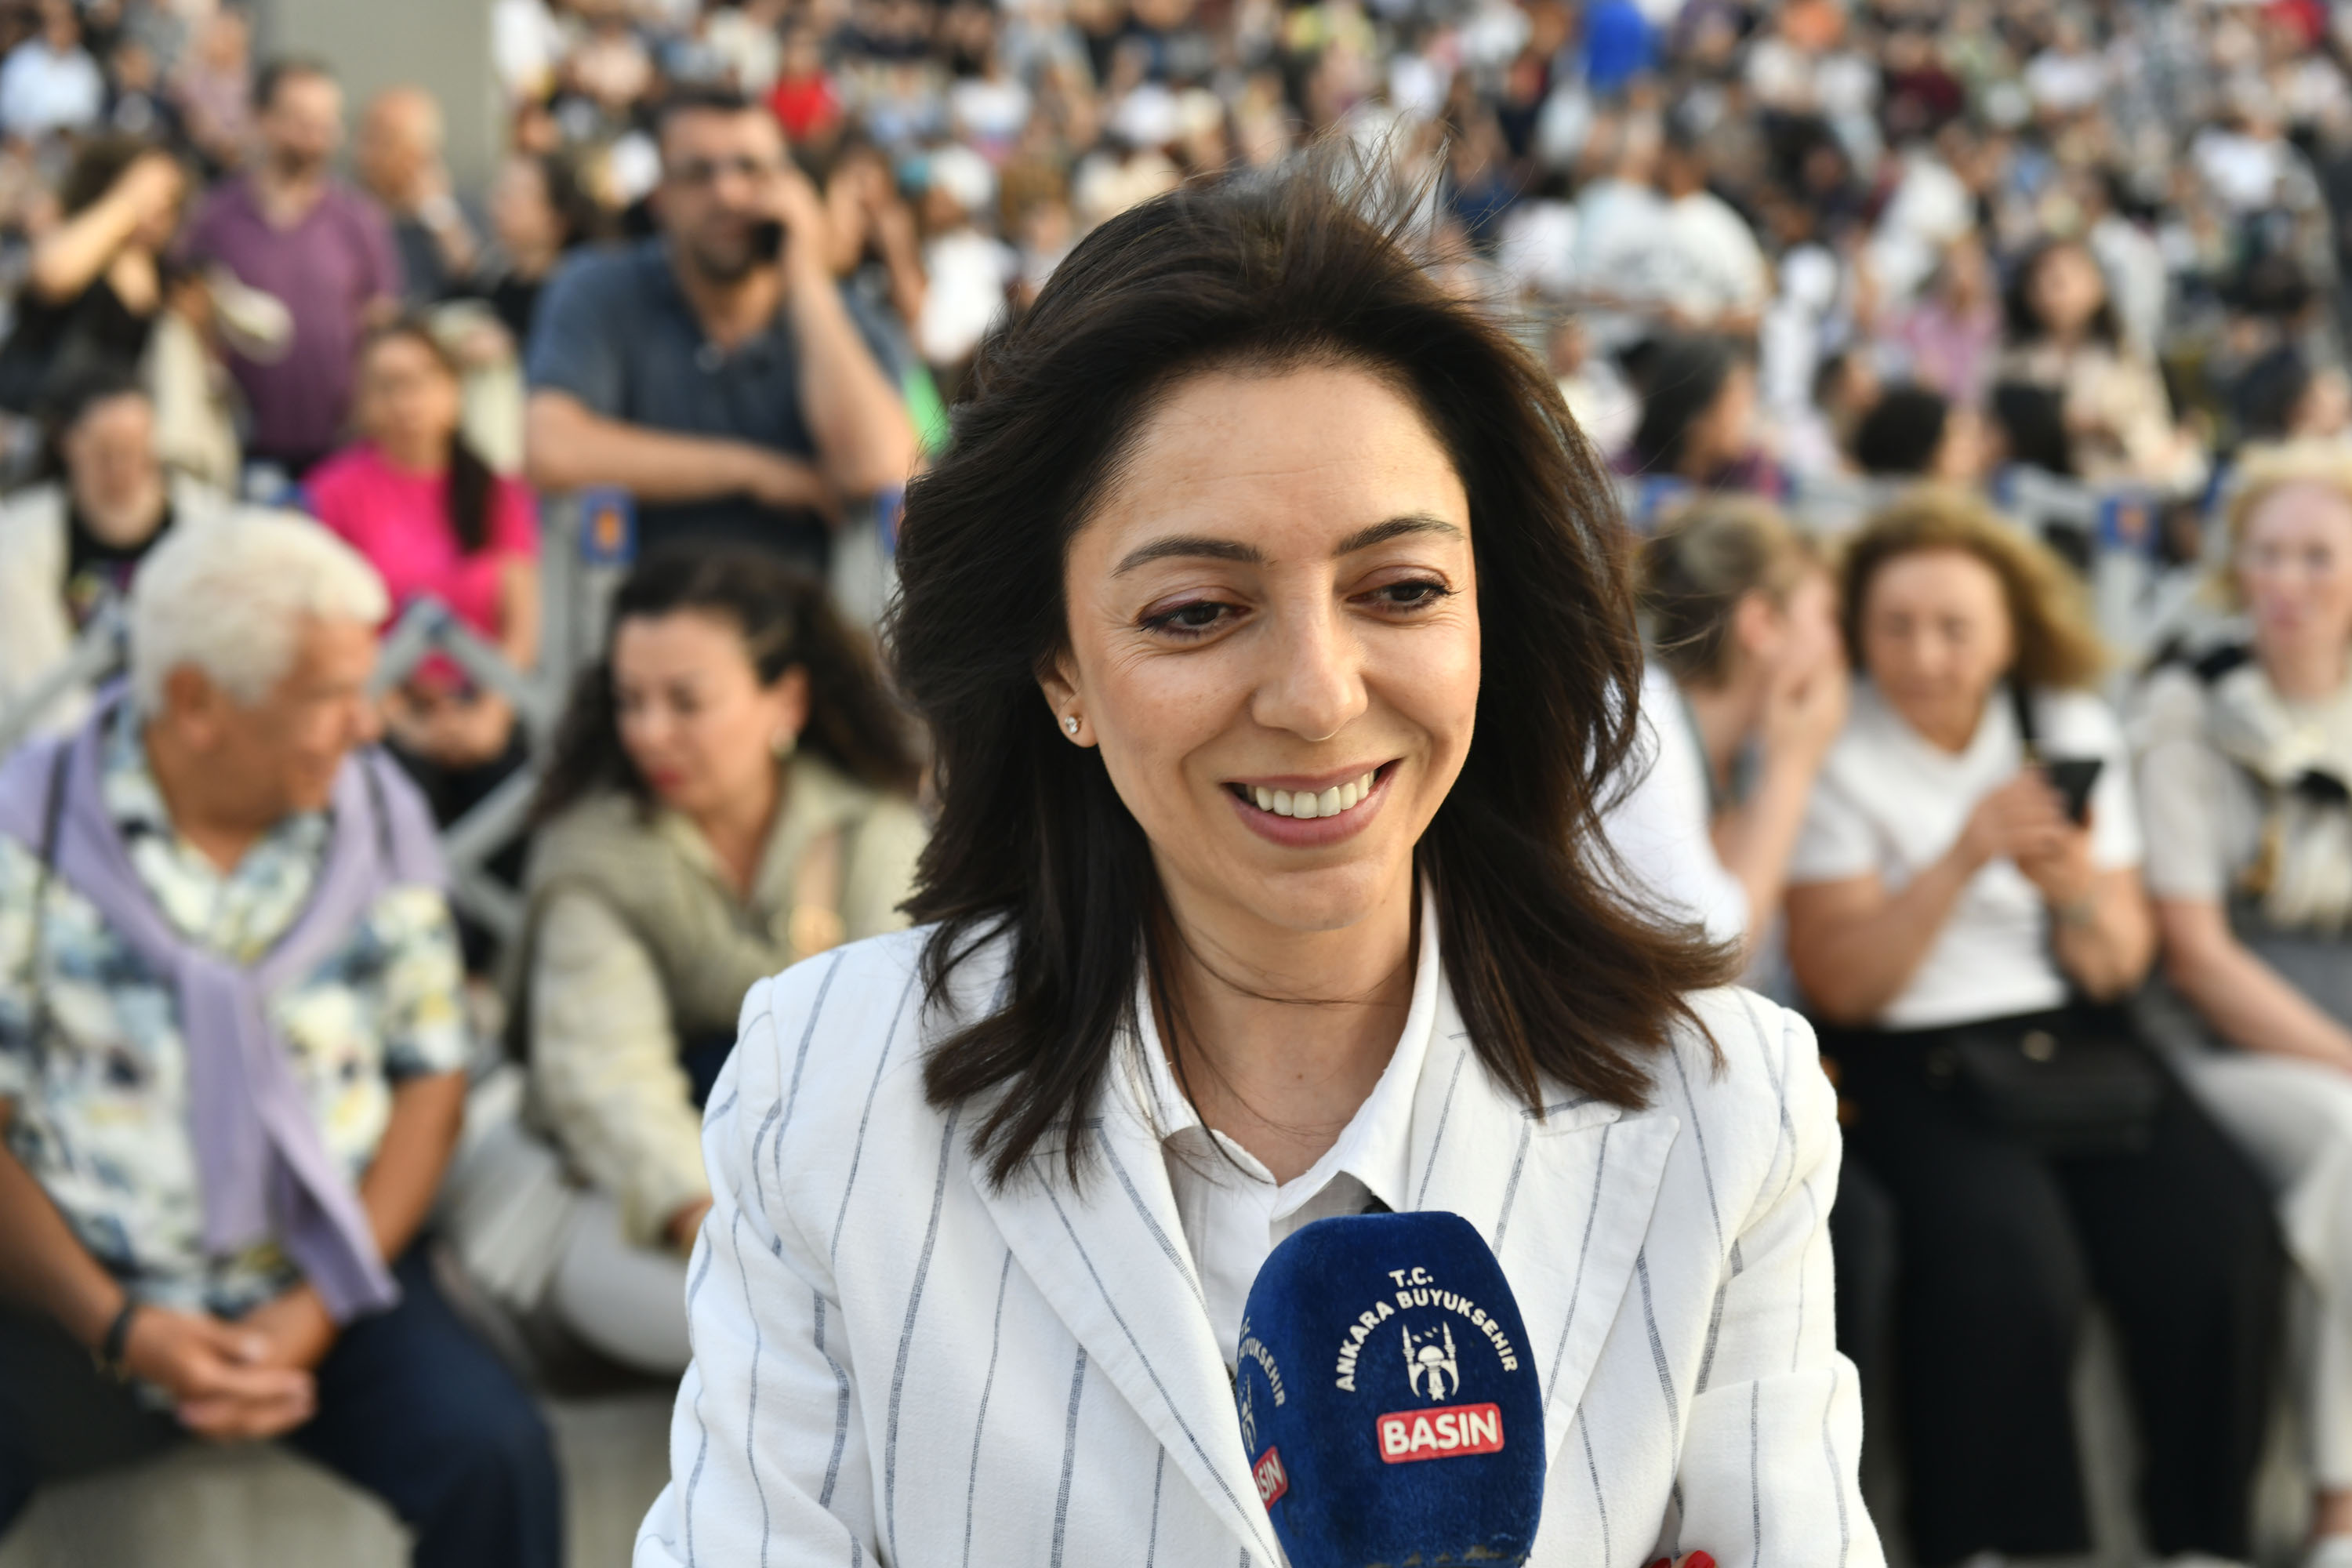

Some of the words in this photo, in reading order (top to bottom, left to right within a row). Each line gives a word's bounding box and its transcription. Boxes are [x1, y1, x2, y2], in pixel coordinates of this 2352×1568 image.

[1388, 1266, 1434, 1287] T.C.
[1335, 1300, 1395, 1392] ANKARA
[1382, 1409, 1498, 1456] BASIN
[1255, 1453, 1283, 1501] SIN
